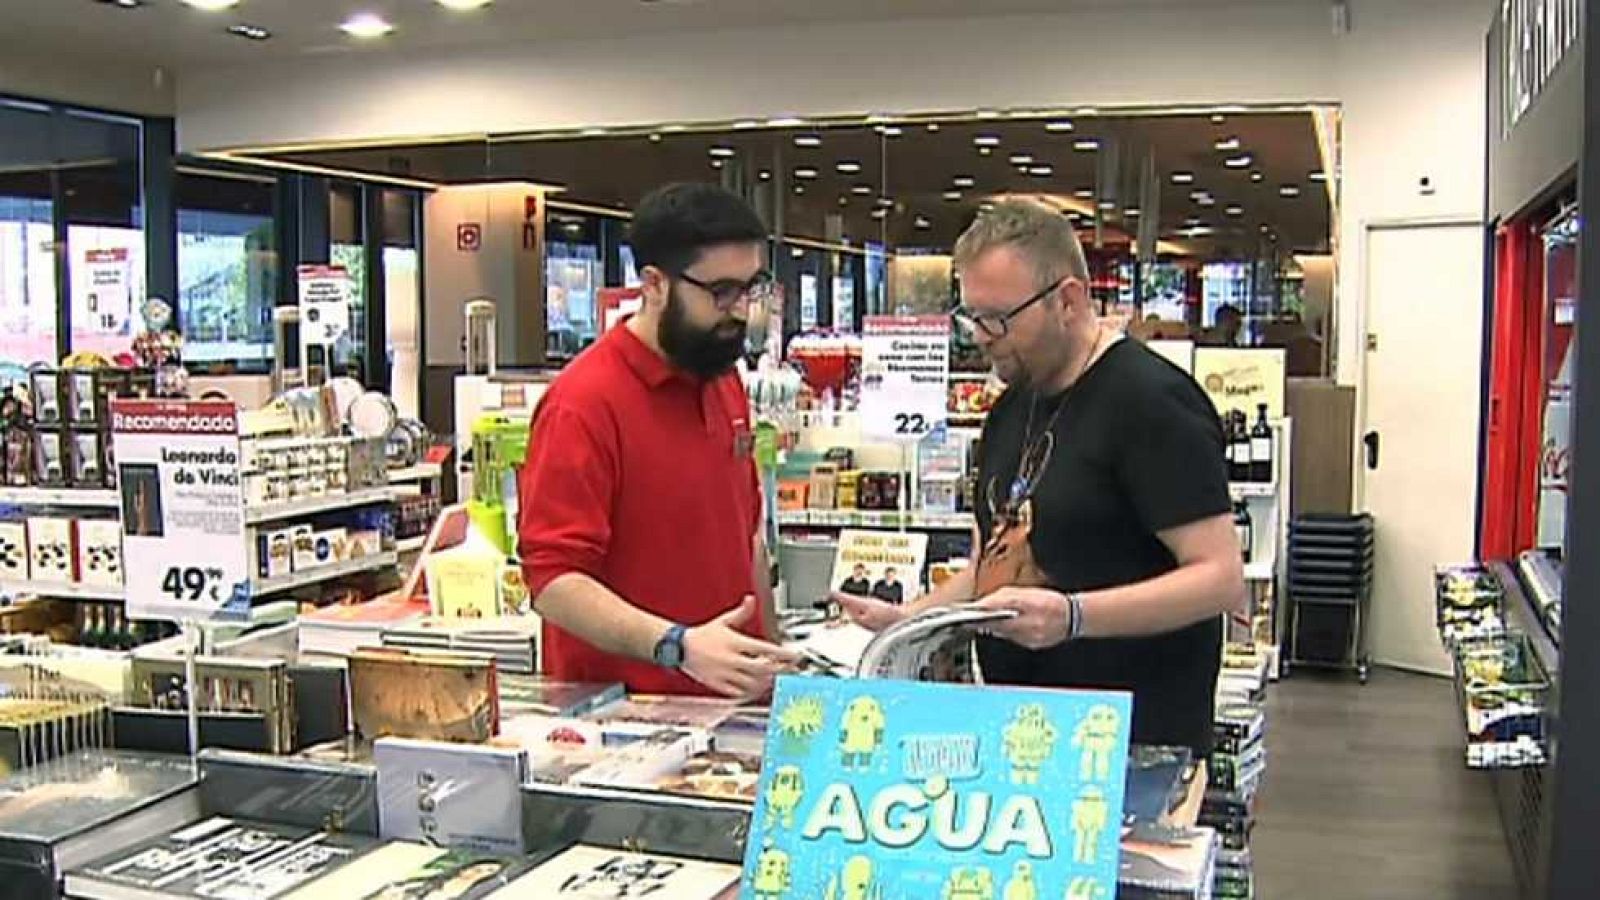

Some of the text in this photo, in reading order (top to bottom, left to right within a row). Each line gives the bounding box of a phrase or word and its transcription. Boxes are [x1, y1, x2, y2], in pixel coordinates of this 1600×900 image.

[112, 411, 235, 432] Recomendado
[161, 445, 236, 464] Leonardo
[174, 466, 239, 486] da Vinci
[801, 782, 1053, 860] AGUA
